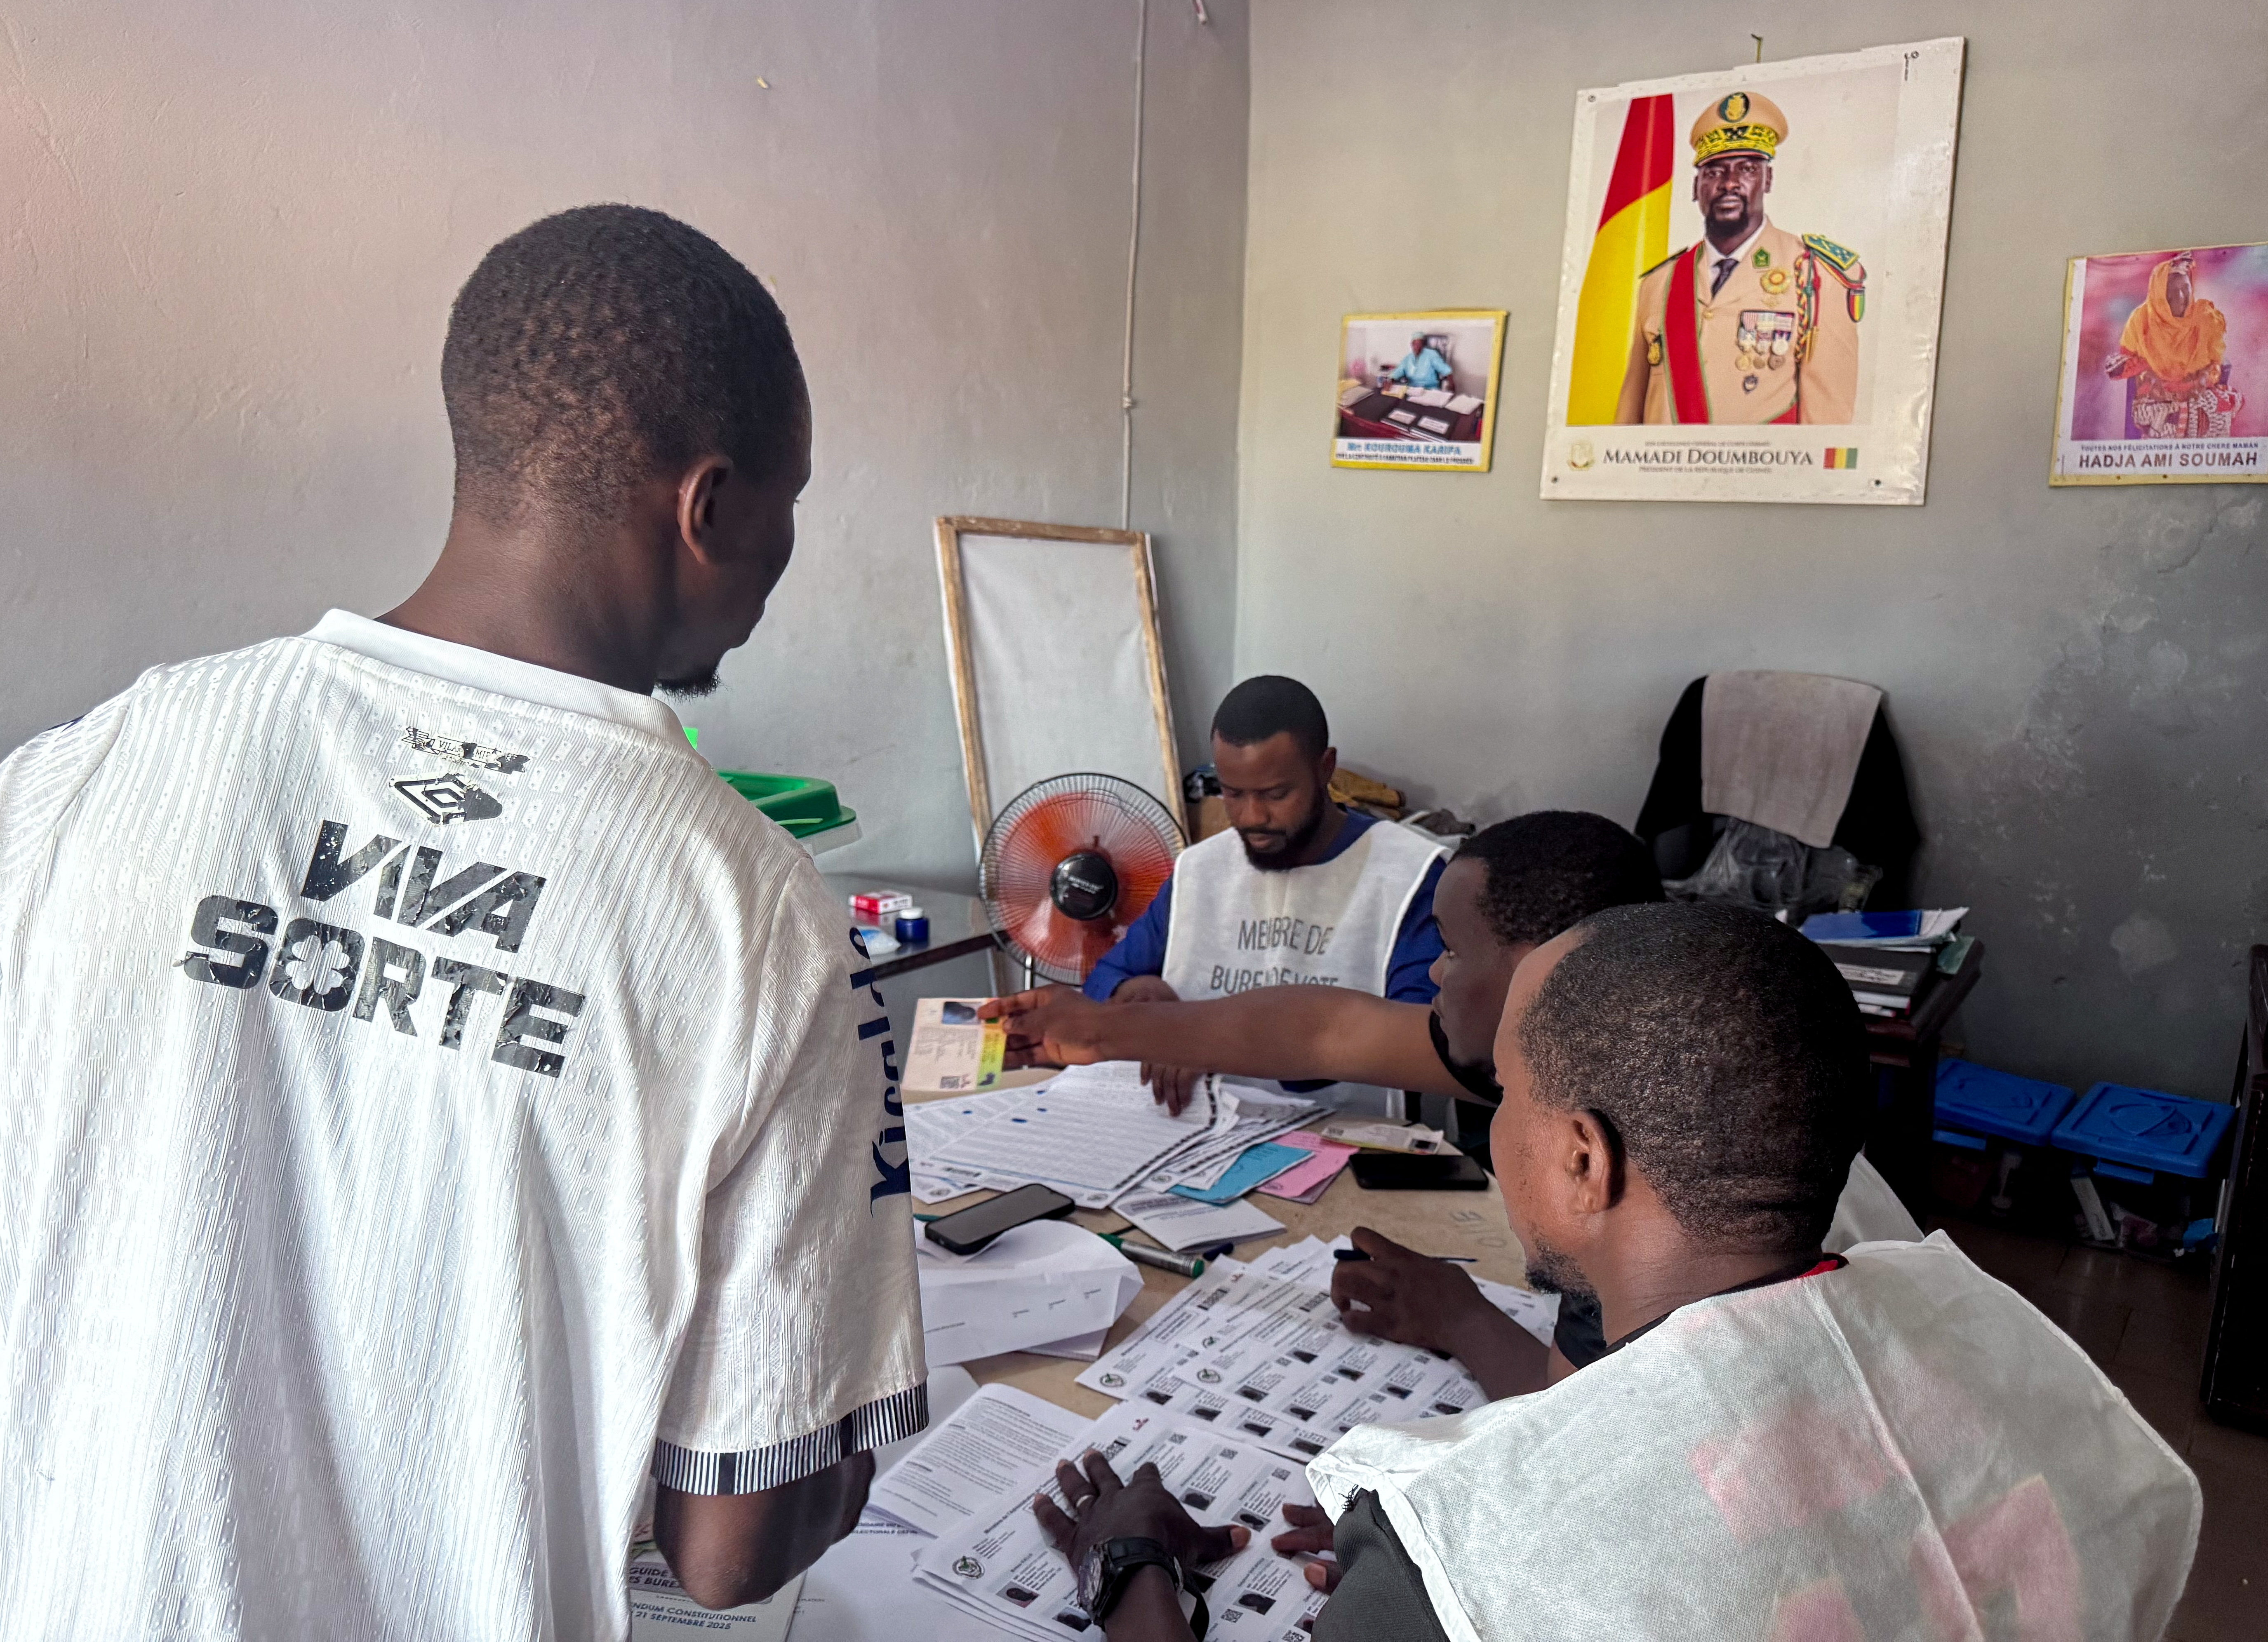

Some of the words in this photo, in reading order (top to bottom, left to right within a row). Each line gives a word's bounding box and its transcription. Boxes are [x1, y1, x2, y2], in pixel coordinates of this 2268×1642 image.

[1603, 448, 1682, 465] MAMADI
[1687, 448, 1813, 466] DOUMBOUYA
[2079, 453, 2136, 468] HADJA
[2141, 453, 2173, 467] AMI
[2179, 451, 2258, 467] SOUMAH
[300, 820, 547, 953] VIVA
[1304, 924, 1334, 955] DE
[183, 895, 586, 1078] SORTE
[629, 1567, 669, 1577] GUIDE
[650, 1613, 703, 1627] SEPTEMBRE
[667, 1607, 757, 1623] CONSTITUTIONNEL
